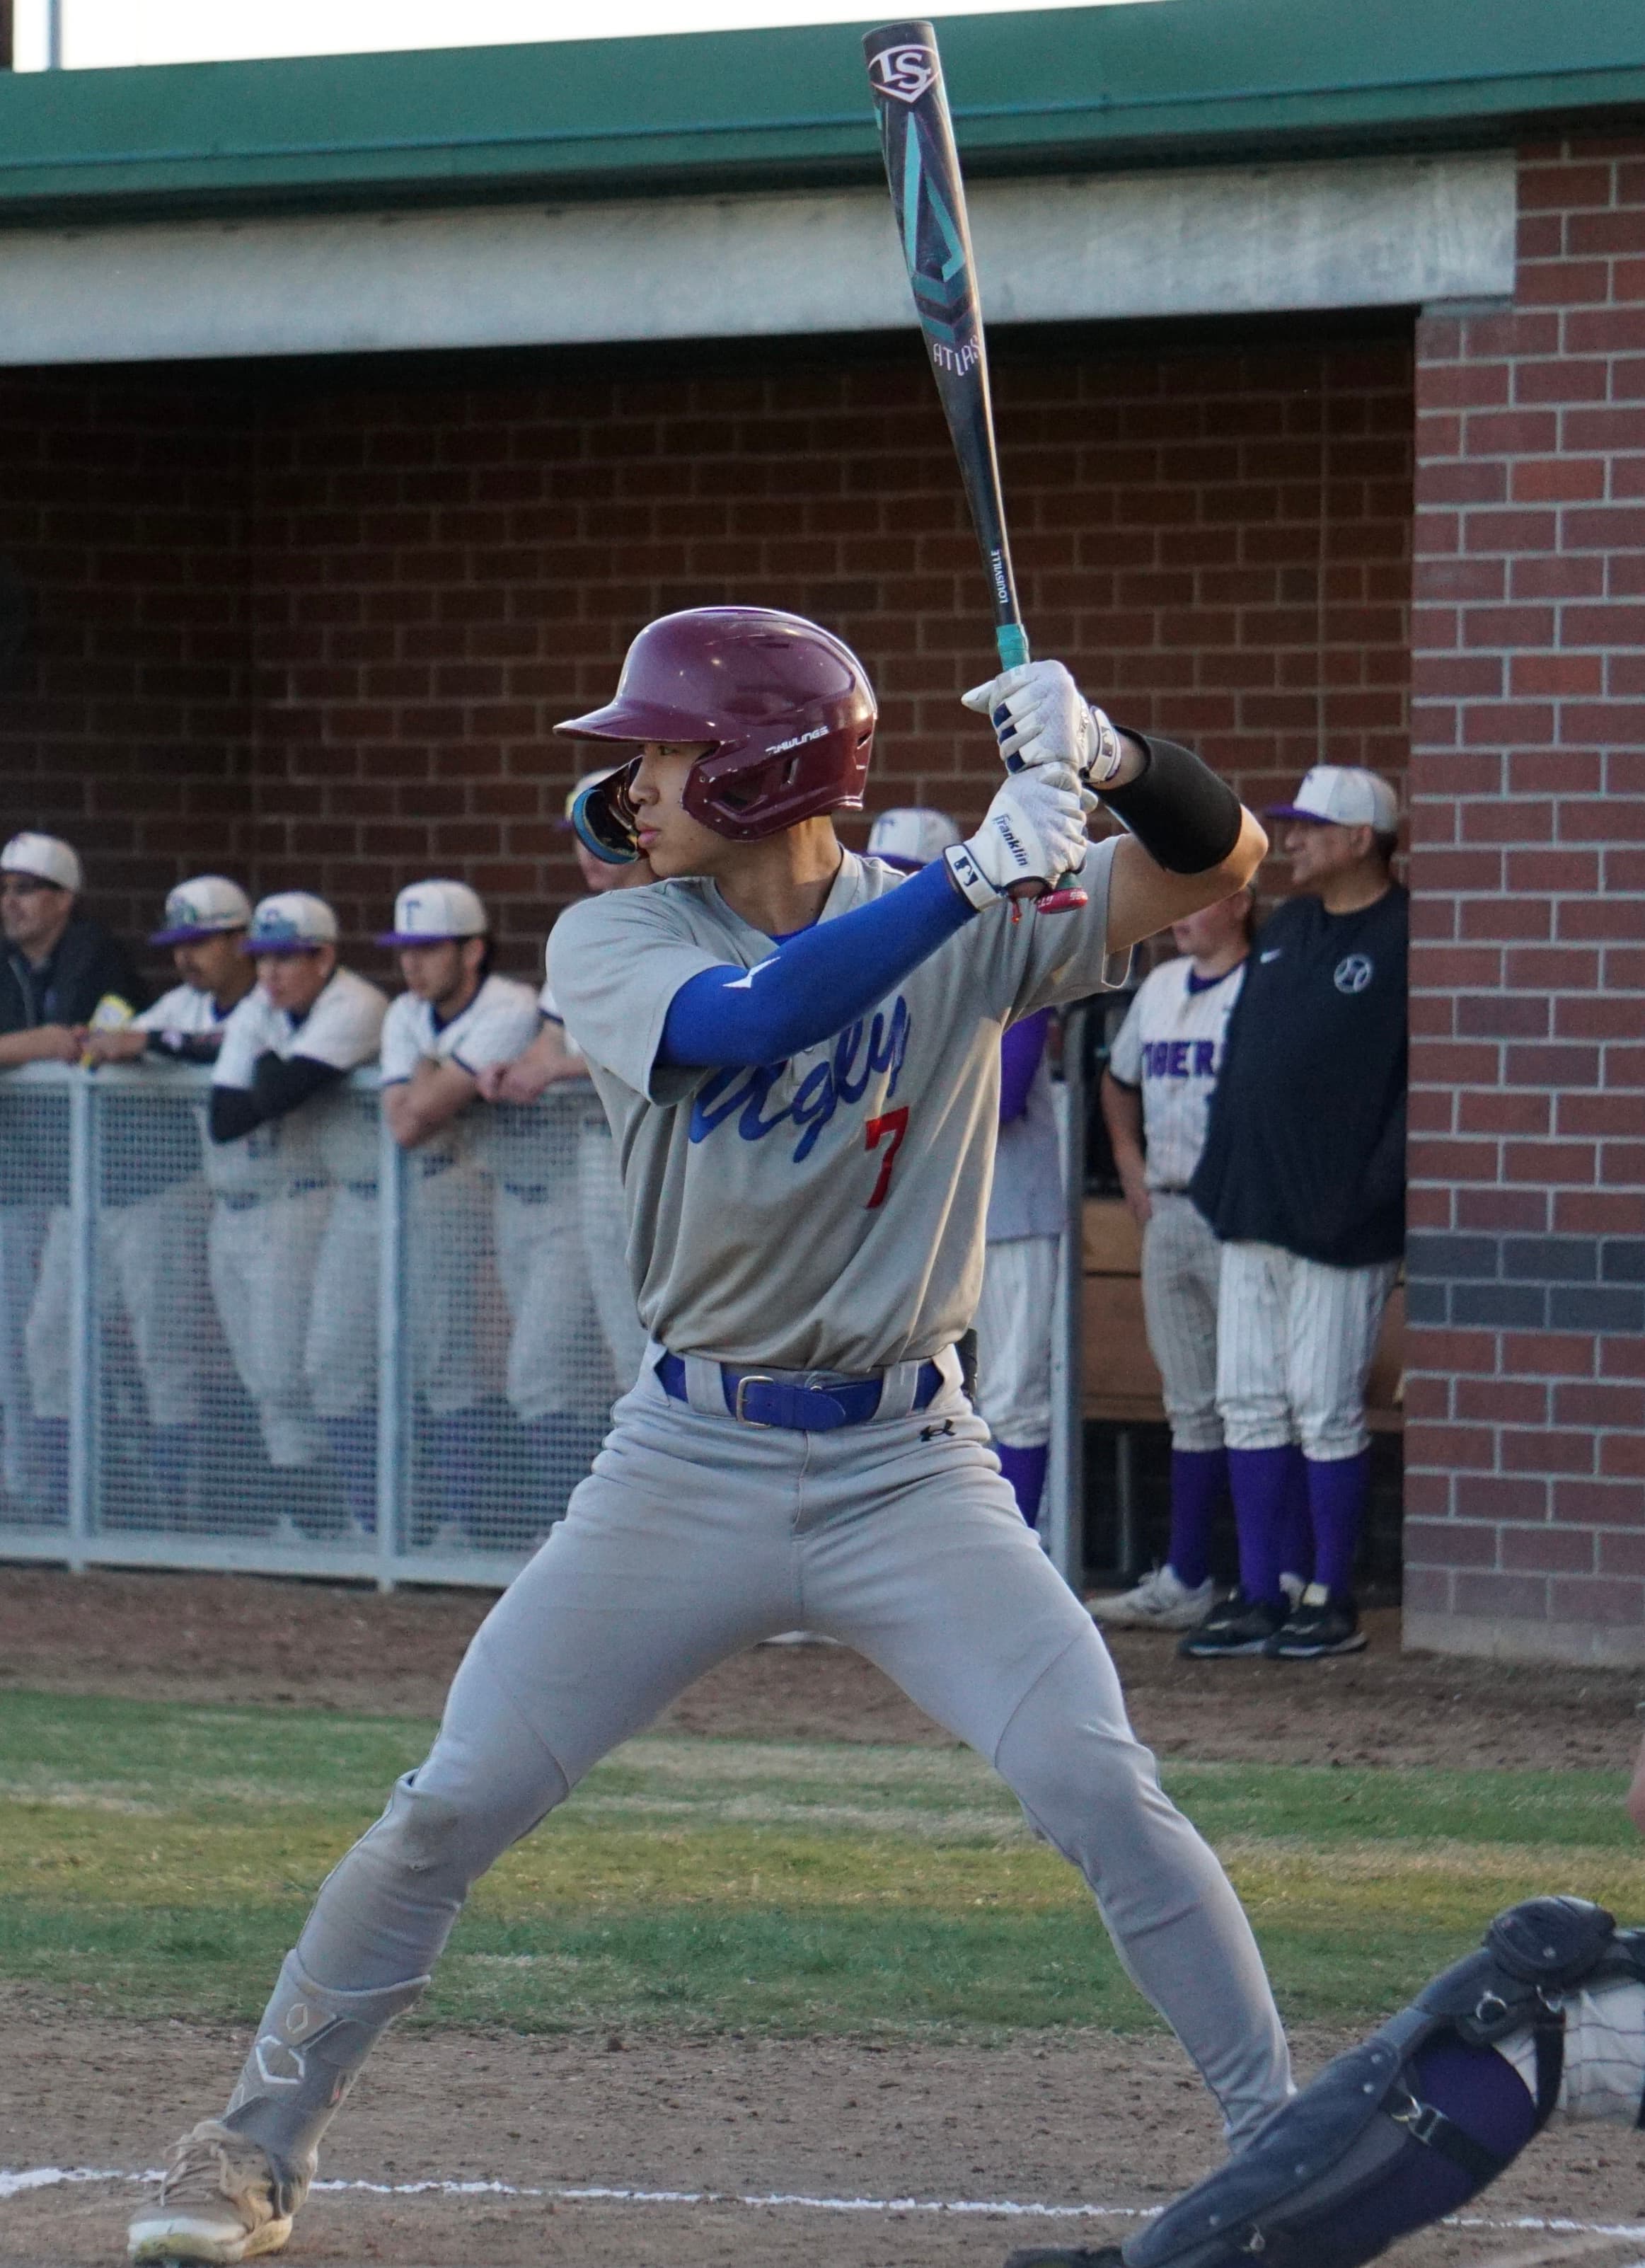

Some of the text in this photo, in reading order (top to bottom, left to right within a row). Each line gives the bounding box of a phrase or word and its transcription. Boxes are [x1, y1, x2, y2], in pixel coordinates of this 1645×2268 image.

[933, 335, 979, 376] ATLAS
[991, 549, 1009, 604] LOUISVILLE
[992, 813, 1029, 866] Franklin
[865, 1105, 909, 1209] 7
